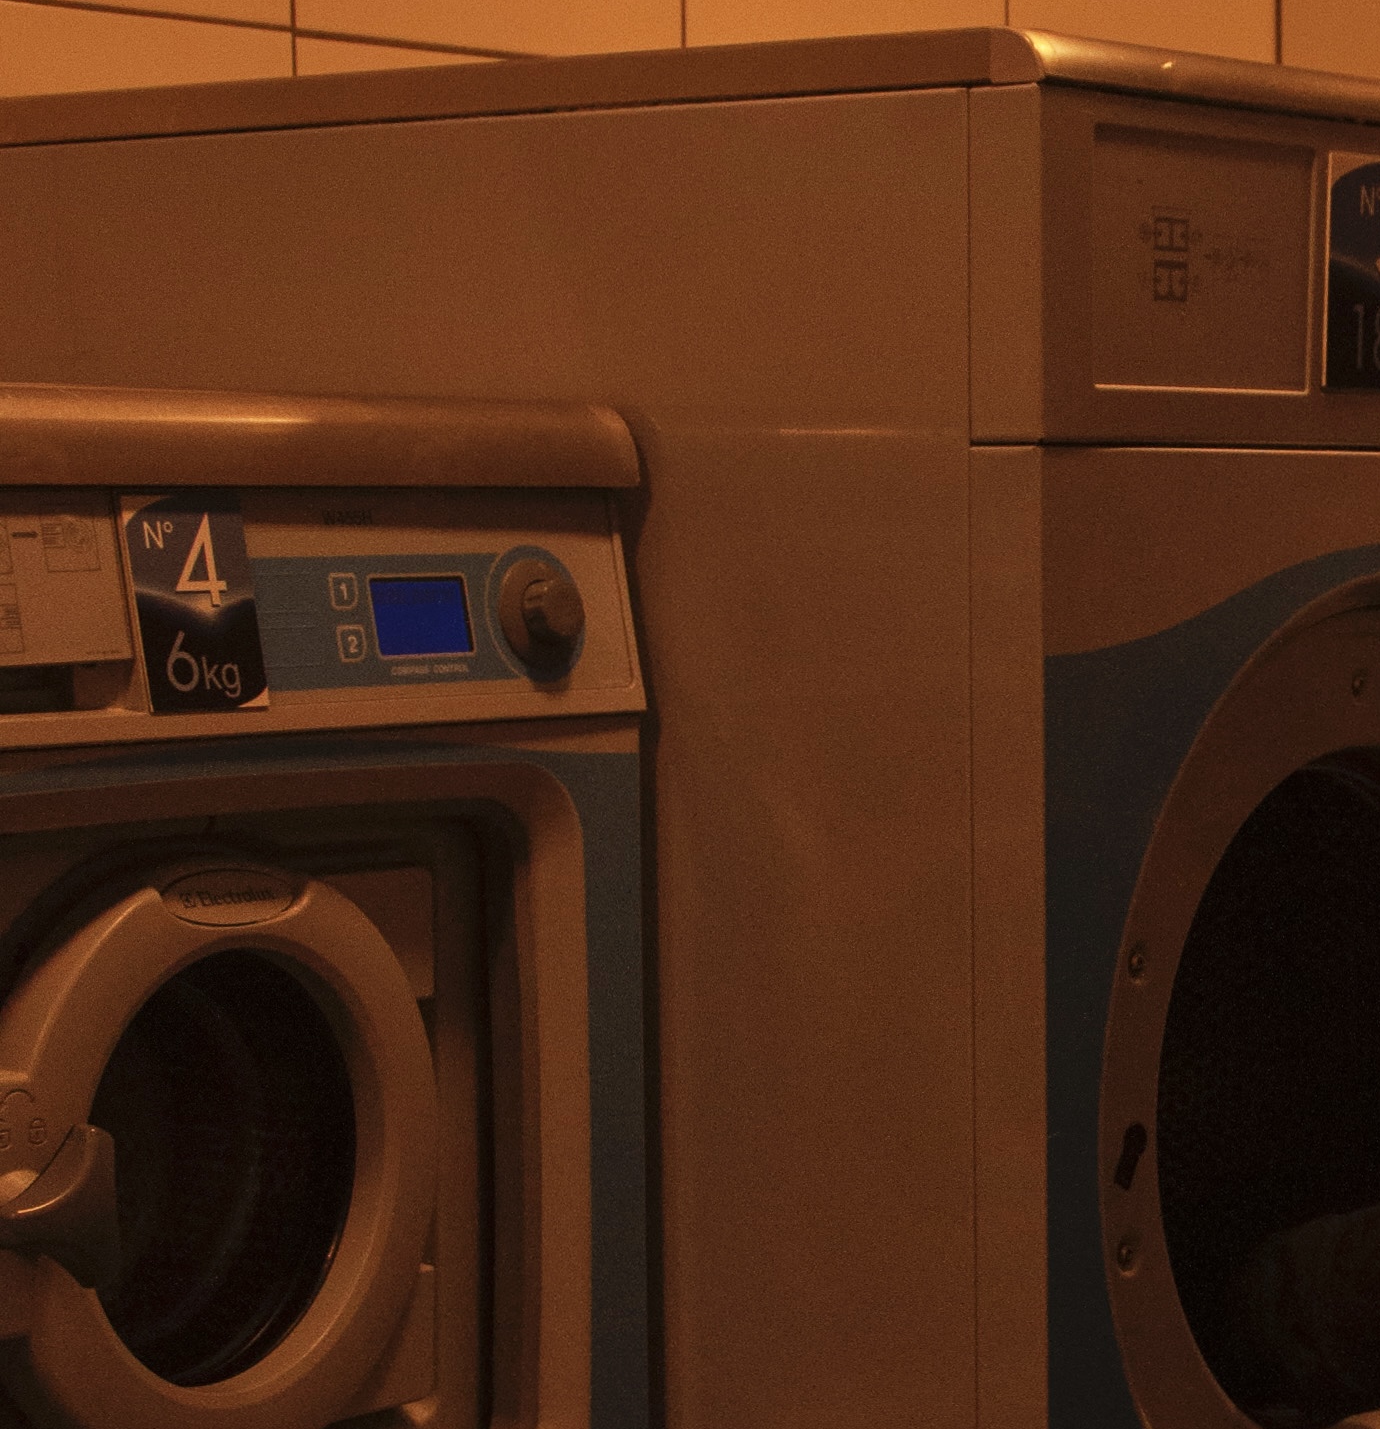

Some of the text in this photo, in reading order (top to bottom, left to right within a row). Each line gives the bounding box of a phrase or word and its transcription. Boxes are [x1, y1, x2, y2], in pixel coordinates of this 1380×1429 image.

[175, 512, 228, 608] 4
[340, 581, 348, 601] 1
[347, 635, 359, 654] 2
[166, 629, 242, 699] 6kg
[196, 887, 277, 908] Electrolux
